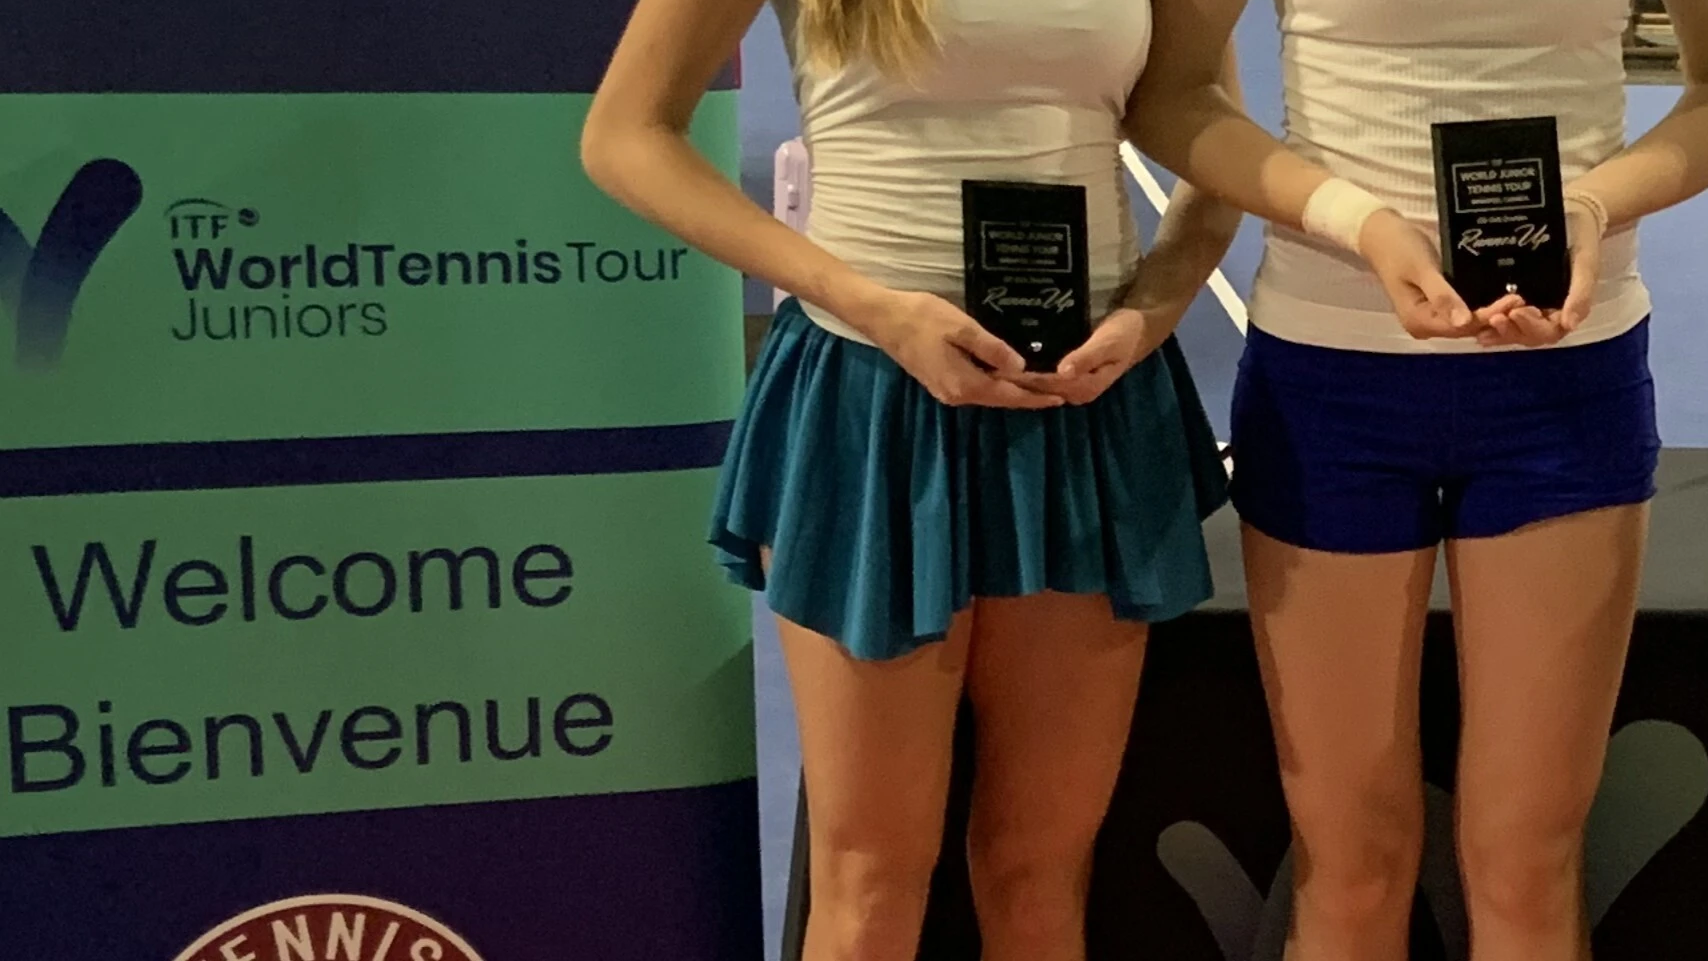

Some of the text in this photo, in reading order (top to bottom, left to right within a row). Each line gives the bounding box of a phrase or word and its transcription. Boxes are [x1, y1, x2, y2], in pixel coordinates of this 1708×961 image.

[171, 213, 229, 239] ITF
[171, 293, 388, 342] Juniors
[32, 536, 574, 632] Welcome
[7, 691, 614, 794] Bienvenue
